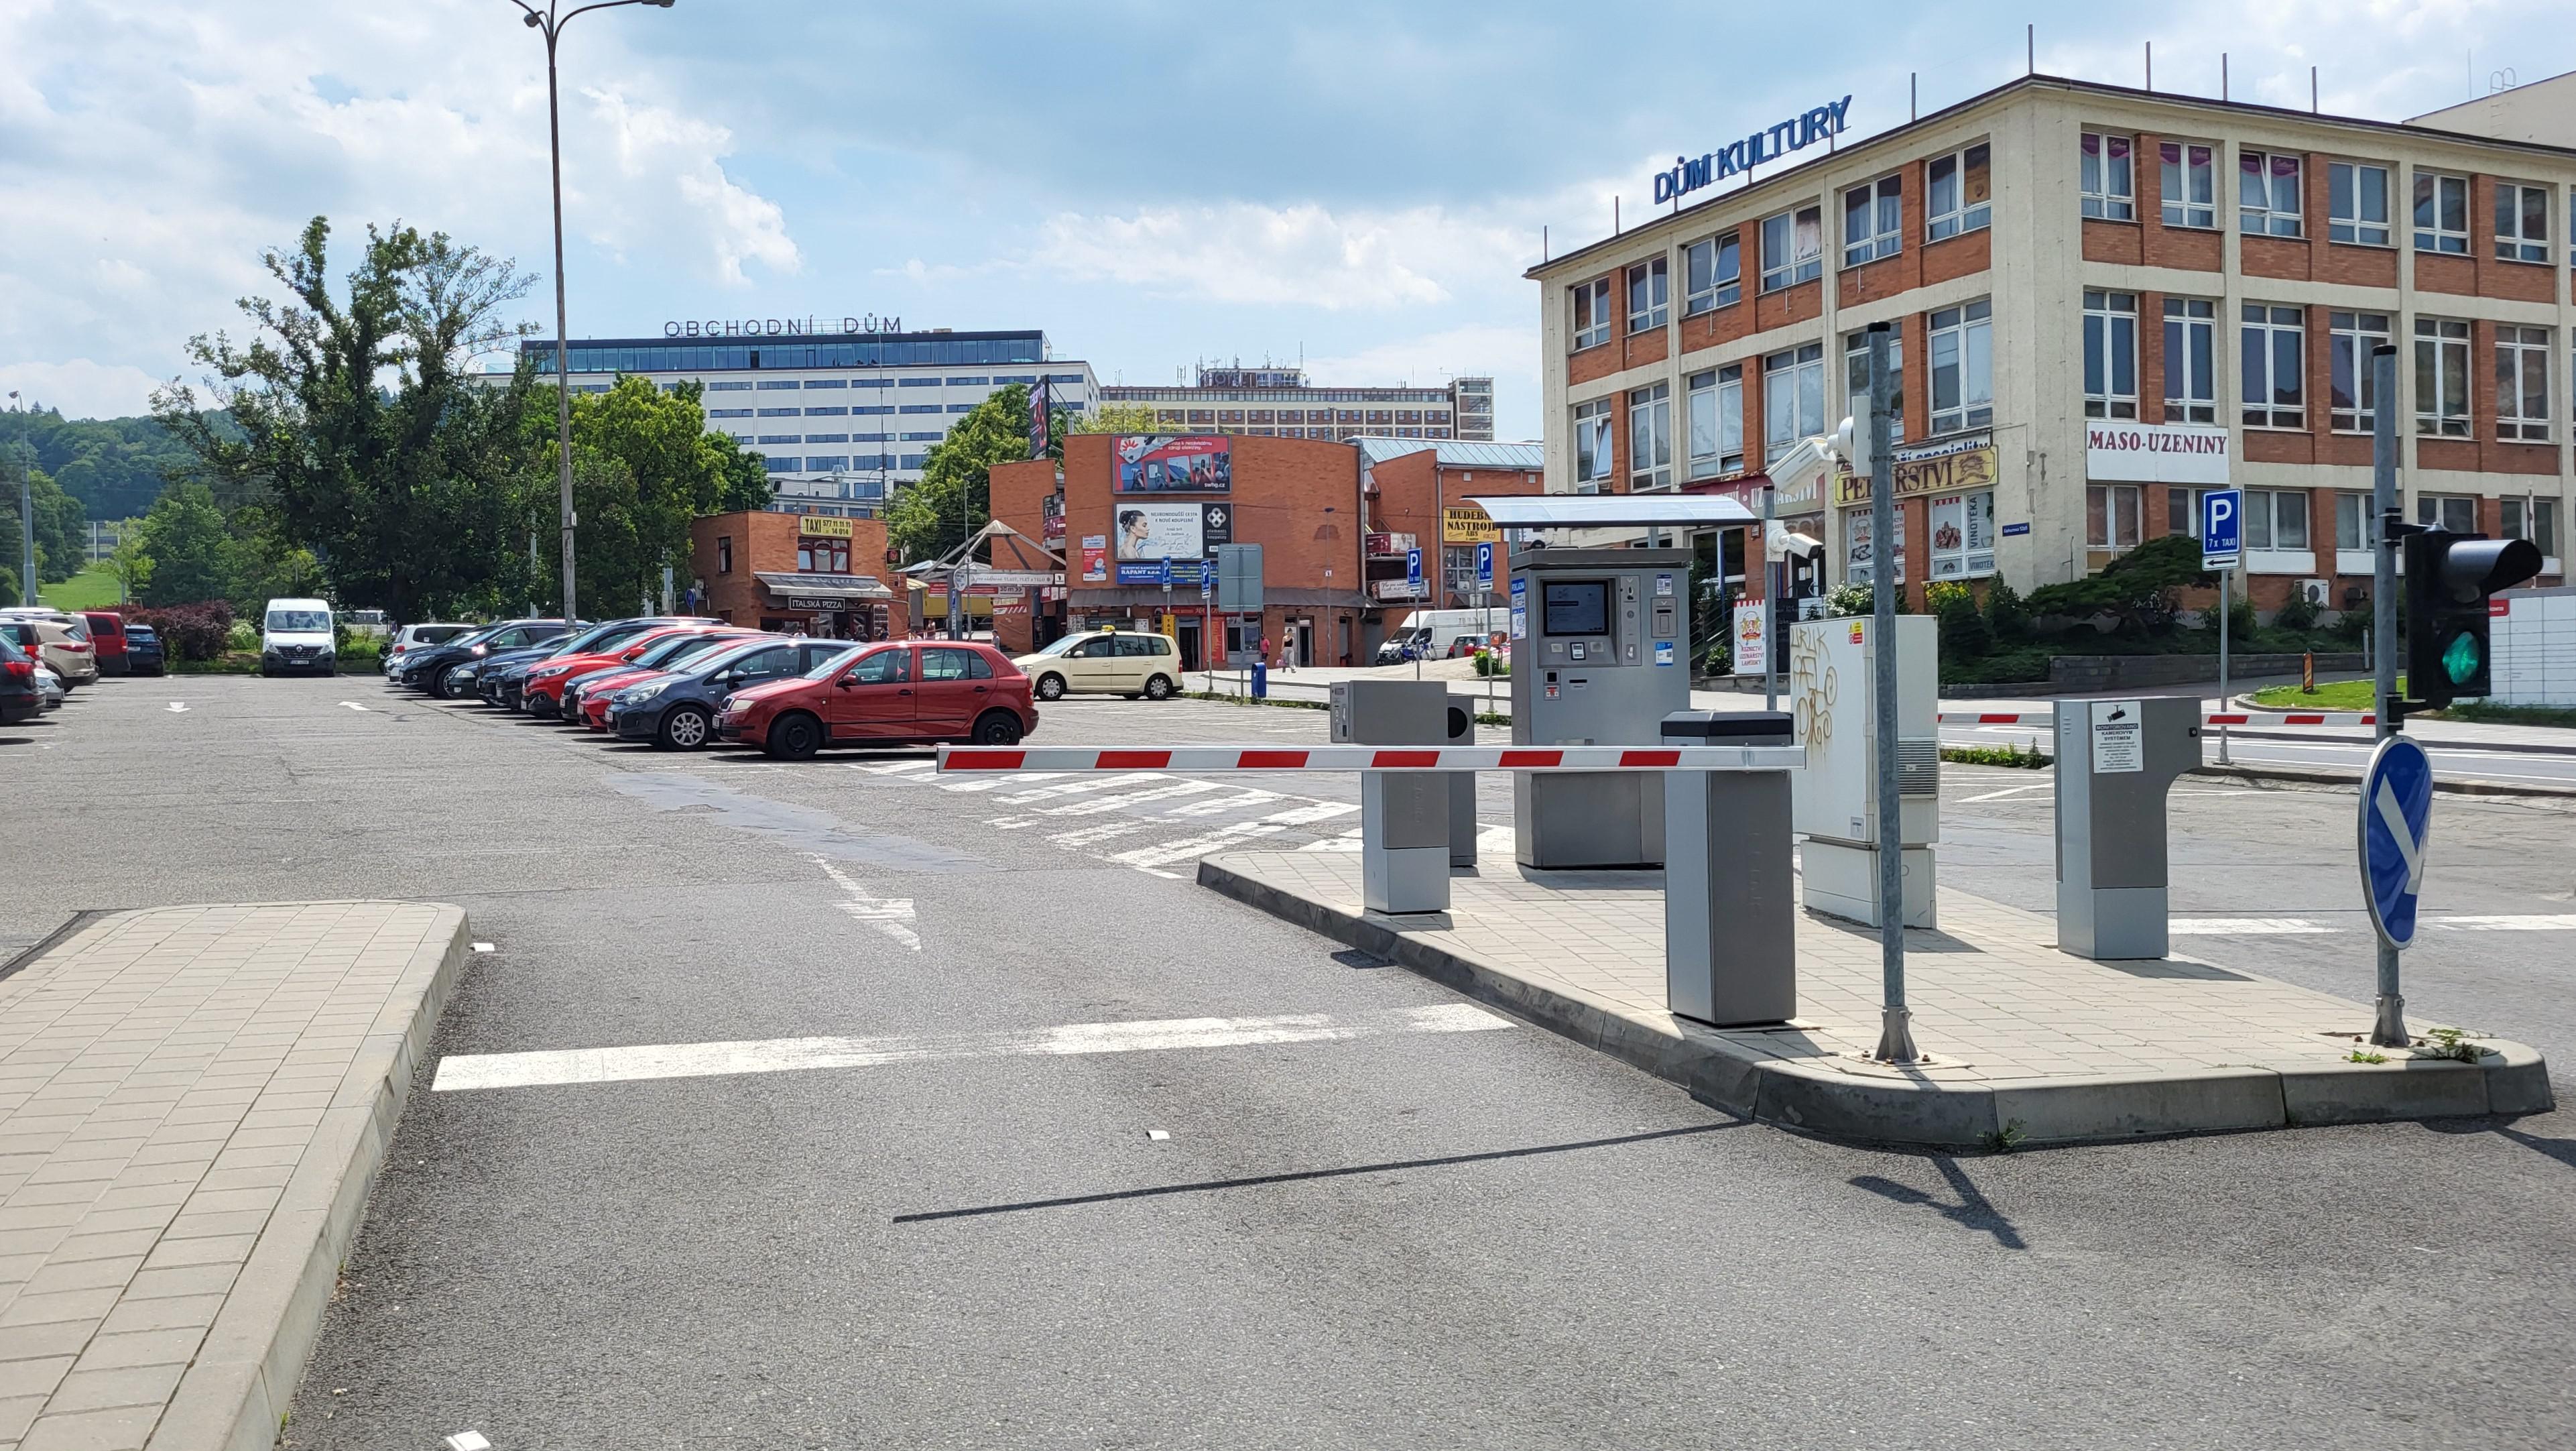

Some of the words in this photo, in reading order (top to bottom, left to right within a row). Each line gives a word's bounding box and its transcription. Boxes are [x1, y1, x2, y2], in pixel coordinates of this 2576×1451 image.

[1654, 156, 1711, 205] DŮM
[1717, 95, 1852, 180] KULTURY
[664, 314, 813, 337] OBCHODNÍ
[844, 312, 901, 334] DŮM
[2087, 430, 2227, 455] MASO-UZENINY
[1841, 456, 1954, 502] PEŘSTVÍ
[805, 518, 821, 533] TAXI
[1449, 510, 1491, 520] HUDEBN
[2211, 499, 2232, 535] P
[2209, 538, 2219, 548] 7x
[2221, 538, 2236, 546] TAXI
[1164, 560, 1169, 577] P
[1410, 553, 1418, 575] P
[1480, 547, 1489, 570] P
[1203, 565, 1208, 582] P
[792, 599, 821, 608] ITALSKÁ
[822, 601, 843, 609] PIZZA
